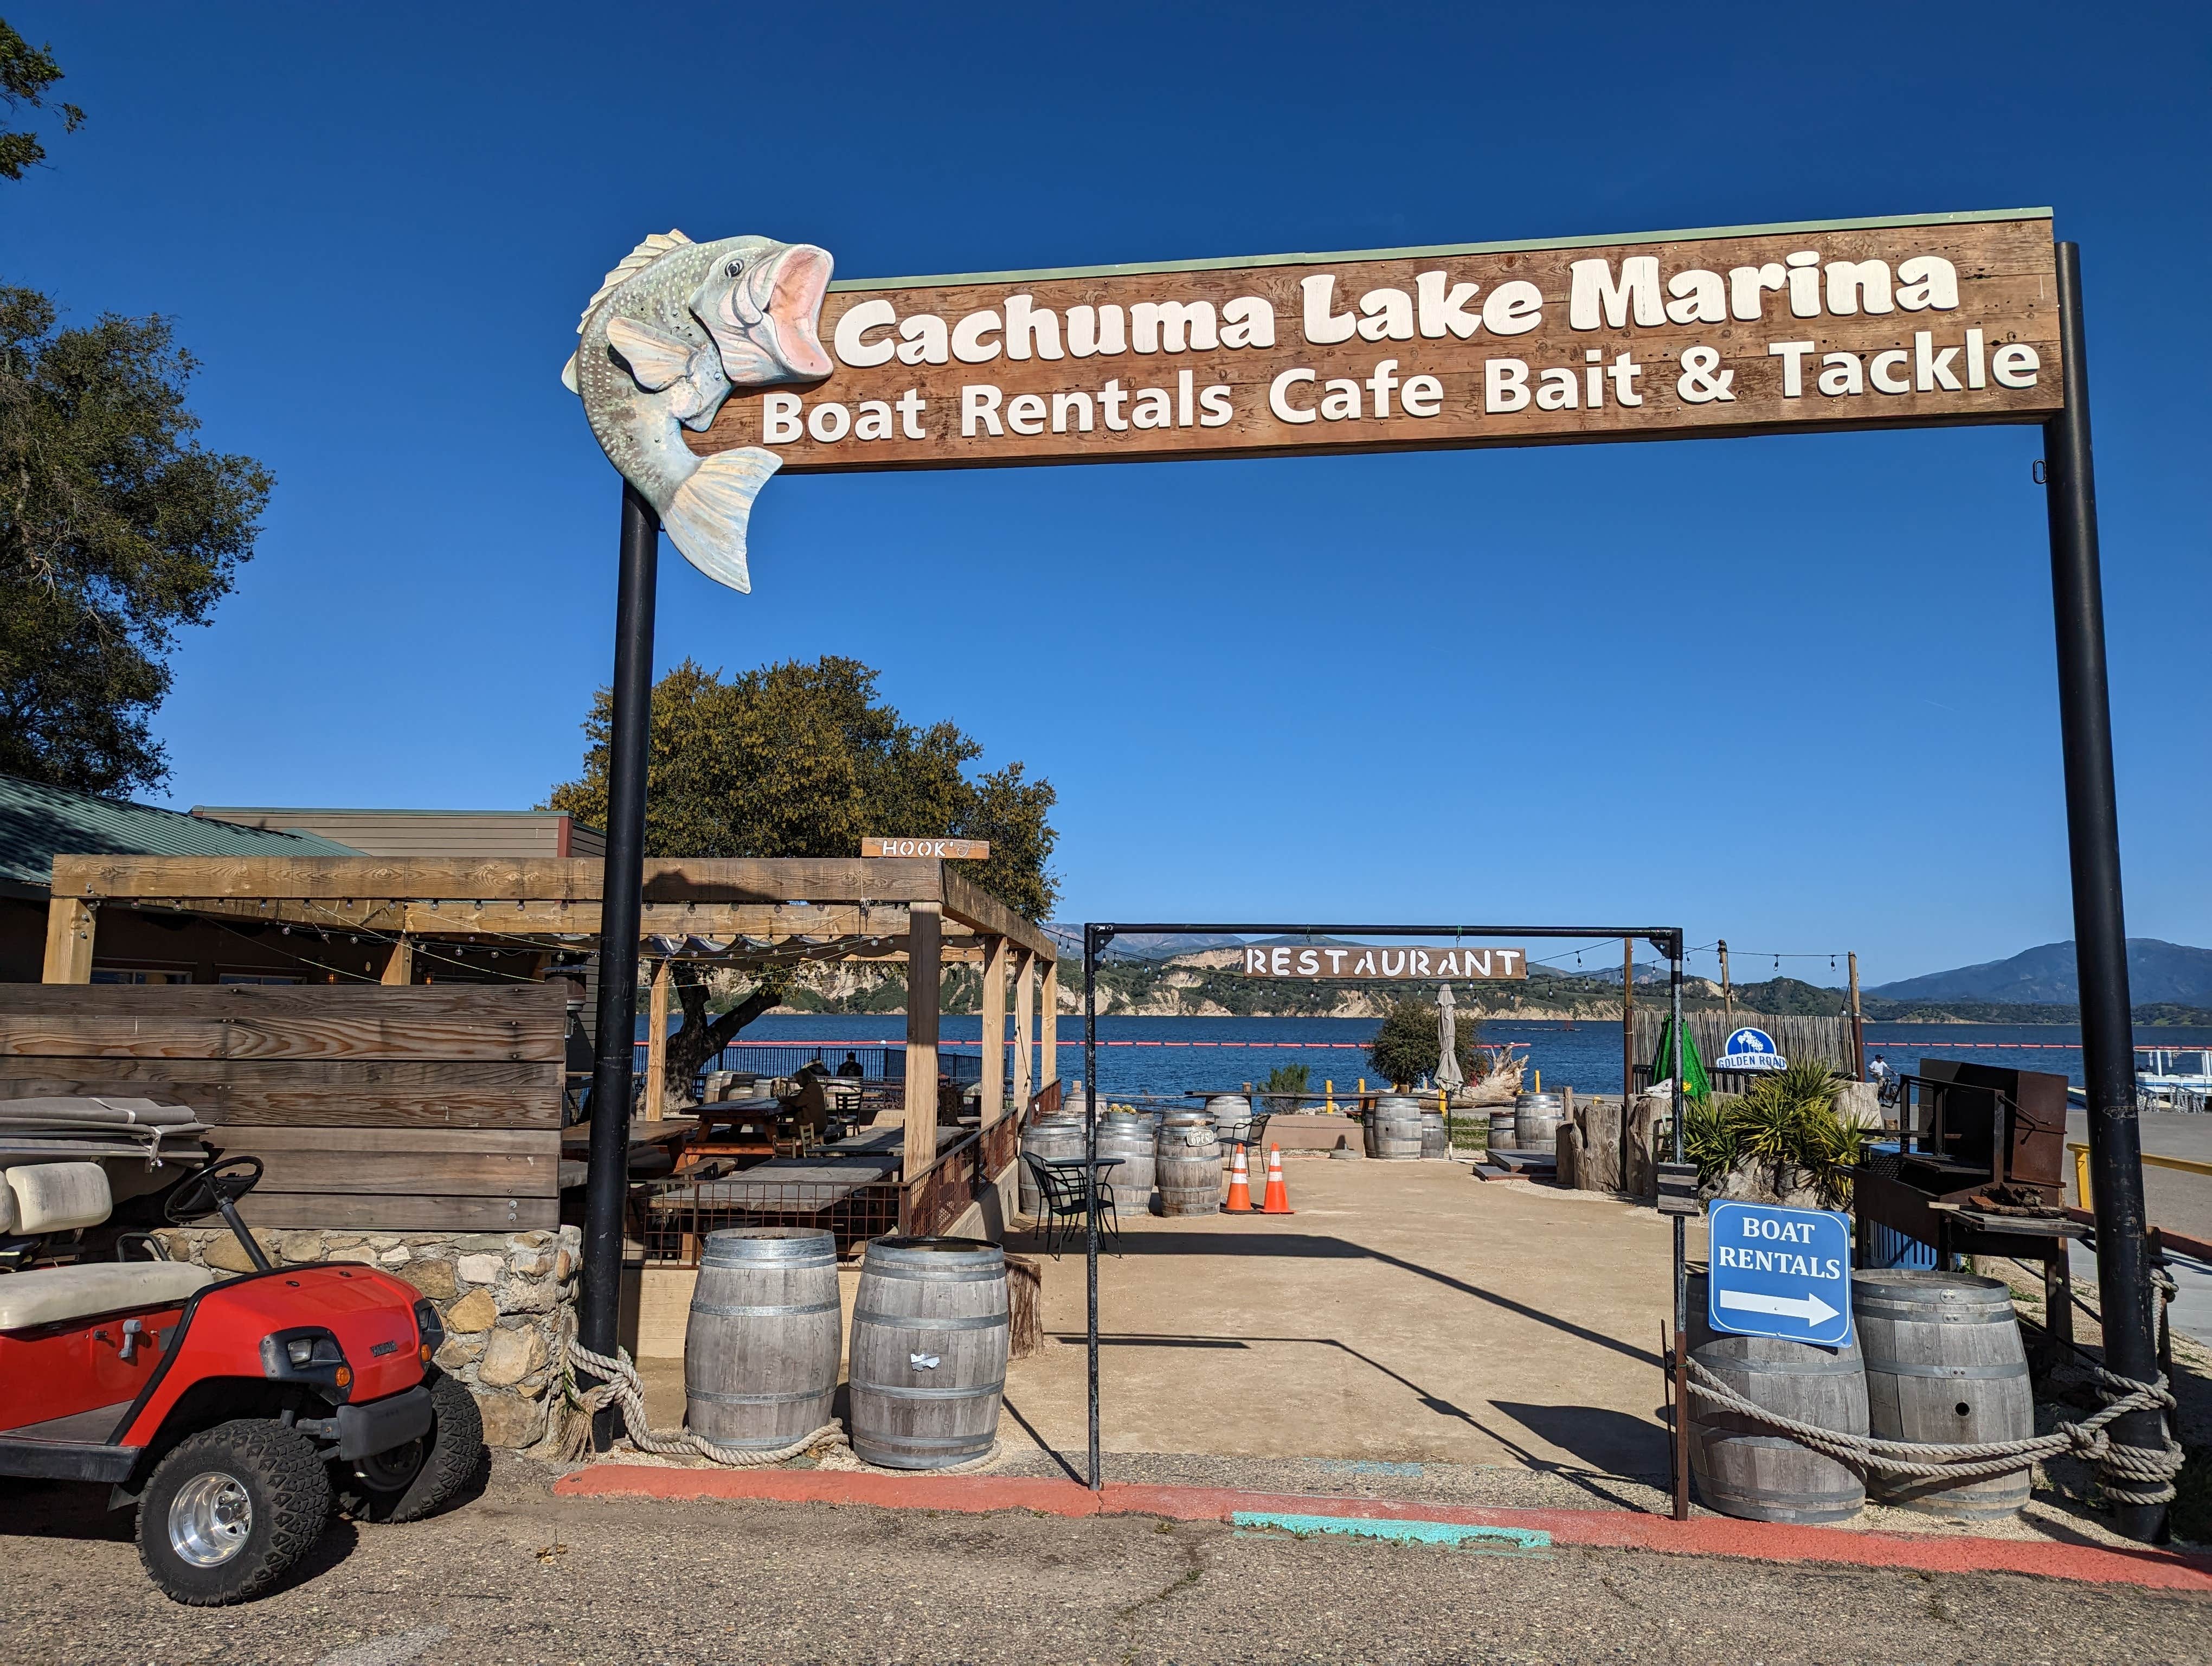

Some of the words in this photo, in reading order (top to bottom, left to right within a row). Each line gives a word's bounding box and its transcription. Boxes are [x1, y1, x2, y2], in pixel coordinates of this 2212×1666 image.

[834, 294, 1275, 367] Cachuma
[1300, 271, 1544, 343] Lake
[1570, 251, 1959, 329] Marina
[763, 388, 926, 444] Boat
[962, 370, 1233, 437] Rentals
[1269, 360, 1444, 423] Cafe
[1485, 349, 1643, 413] Bait
[1677, 345, 1737, 402] &
[1769, 328, 2040, 396] Tackle
[1246, 947, 1521, 977] RESTAURANT
[1719, 1055, 1756, 1068] GOLDEN
[1759, 1056, 1785, 1068] ROAD
[1191, 1136, 1210, 1144] OPEN
[1742, 1217, 1815, 1244] BOAT
[1719, 1246, 1841, 1280] RENTALS
